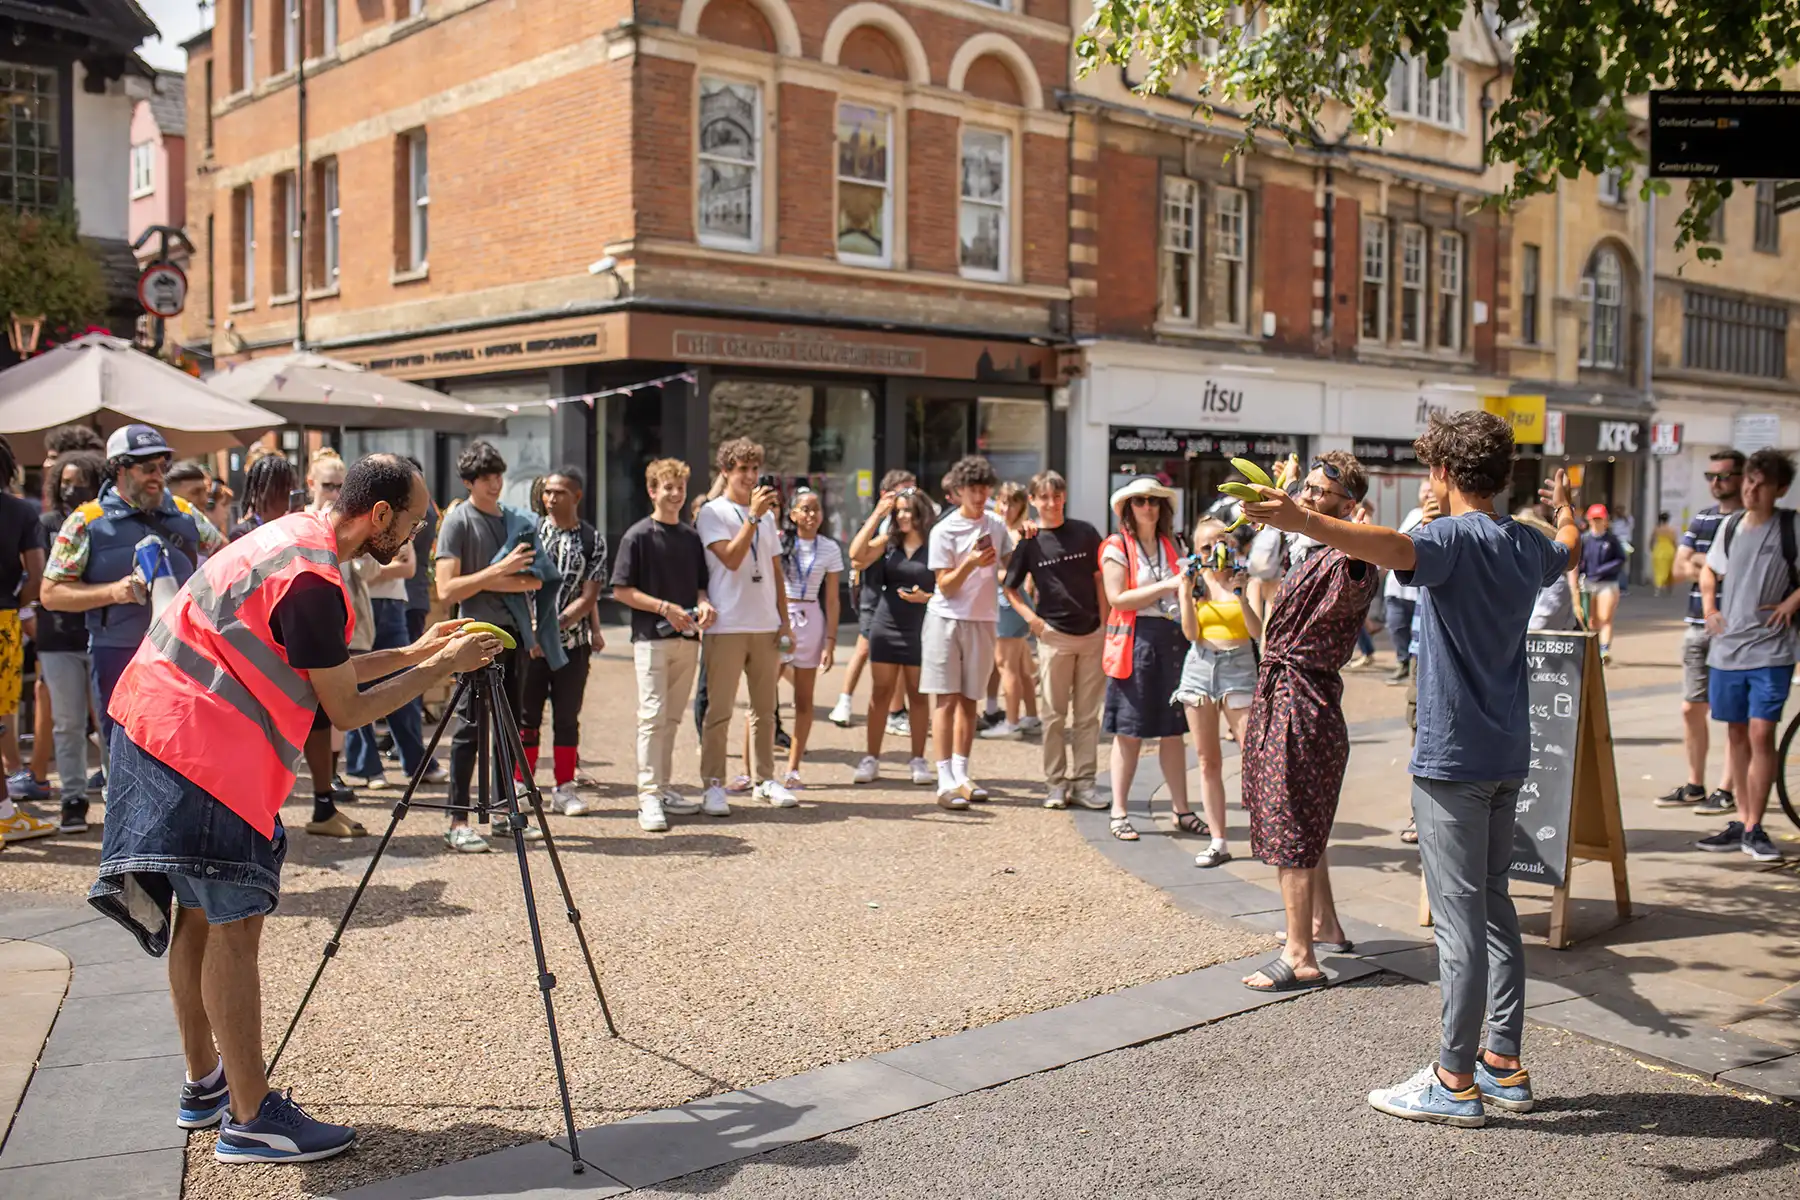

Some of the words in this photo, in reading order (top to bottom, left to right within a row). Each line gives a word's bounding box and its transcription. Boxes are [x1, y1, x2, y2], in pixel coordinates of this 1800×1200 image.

[1748, 96, 1777, 105] Station
[1658, 117, 1688, 127] Oxford
[1690, 117, 1715, 127] Castle
[1658, 162, 1689, 172] Central
[1691, 162, 1719, 173] Library
[1202, 379, 1243, 413] itsu
[1597, 420, 1640, 452] KFC
[1146, 436, 1178, 452] salads
[1187, 438, 1213, 453] sushi
[1526, 640, 1574, 654] HEESE
[1529, 704, 1551, 721] EYS,
[1509, 861, 1545, 875] .co.uk
